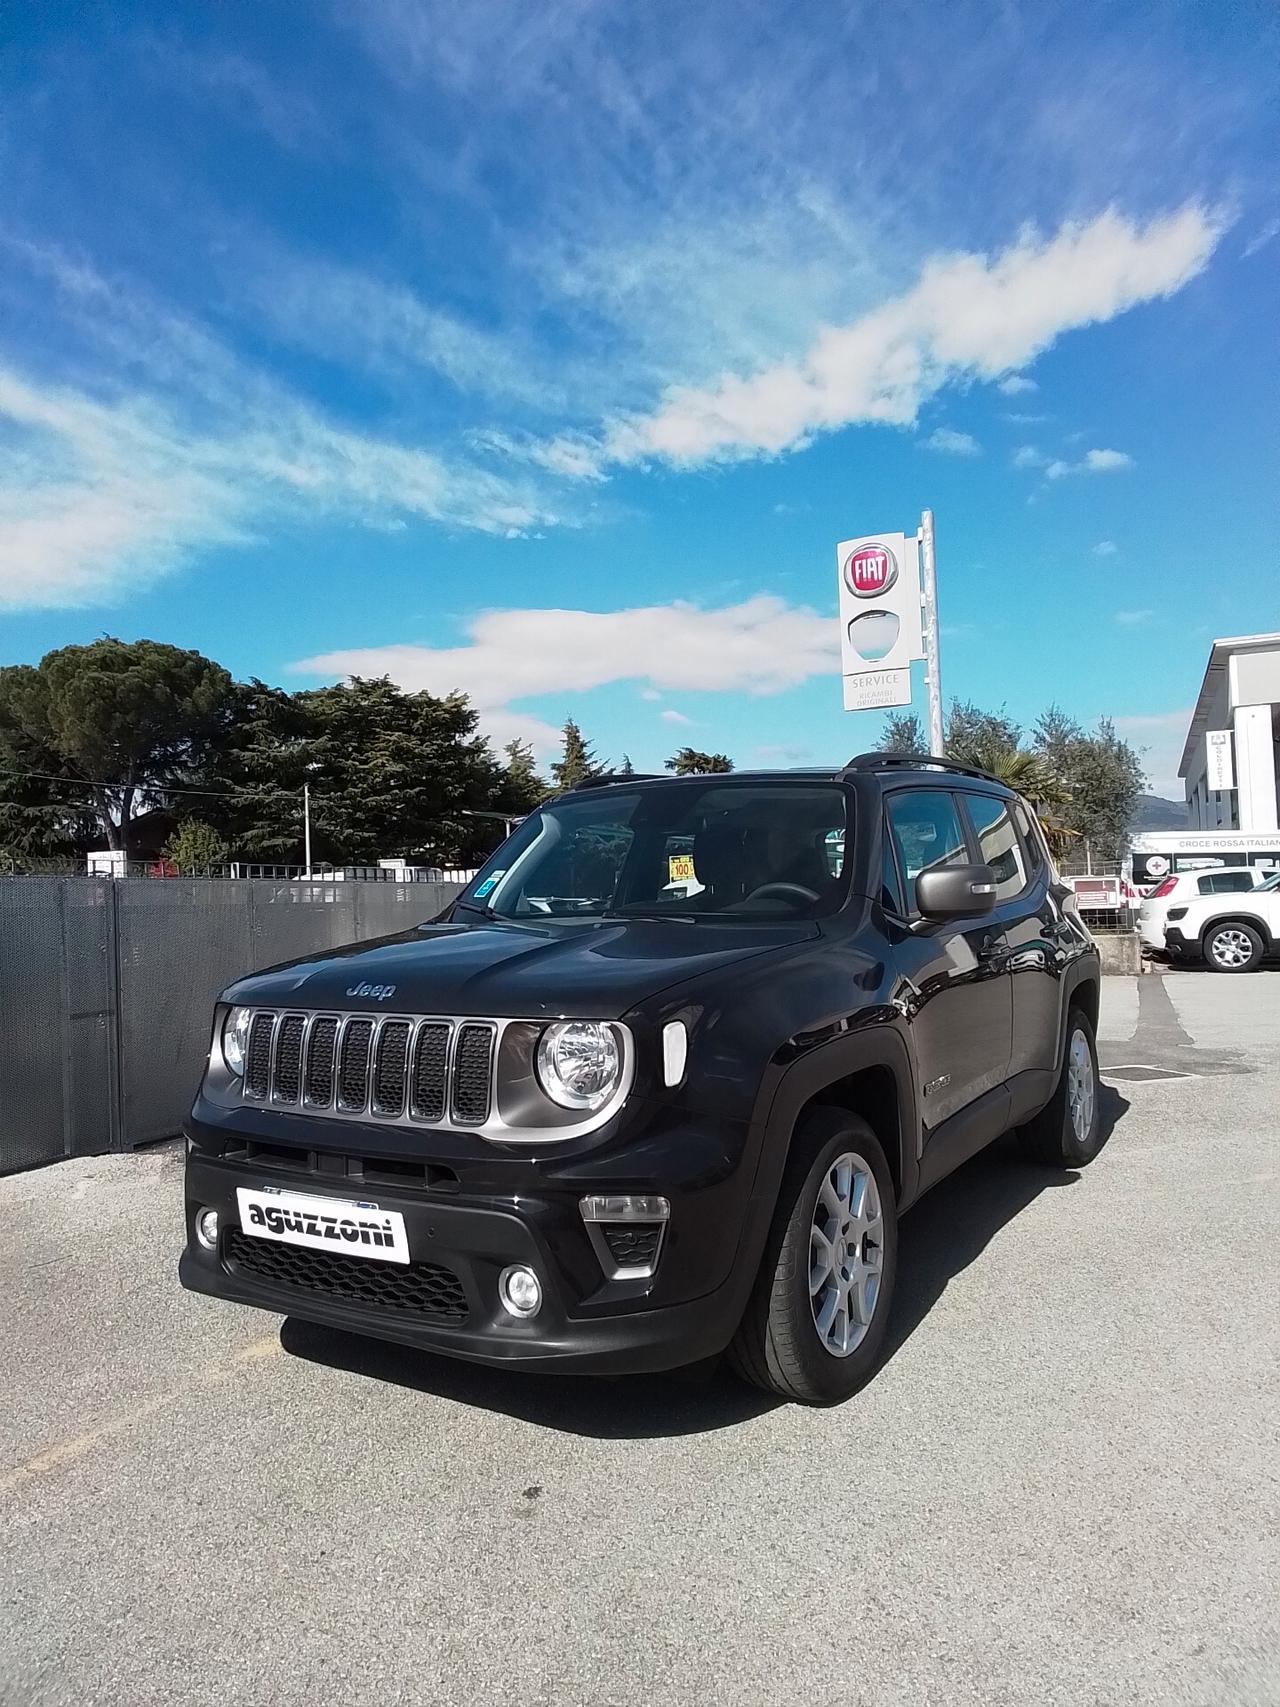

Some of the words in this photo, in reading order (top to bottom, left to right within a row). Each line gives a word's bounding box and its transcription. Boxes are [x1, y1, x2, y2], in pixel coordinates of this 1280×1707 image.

[854, 555, 886, 584] FIAT
[852, 674, 899, 689] SERVICE
[1179, 840, 1212, 848] CROCE
[1213, 839, 1245, 847] ROSSA
[346, 980, 397, 1001] Jeep
[248, 1203, 395, 1248] aguzzoni
